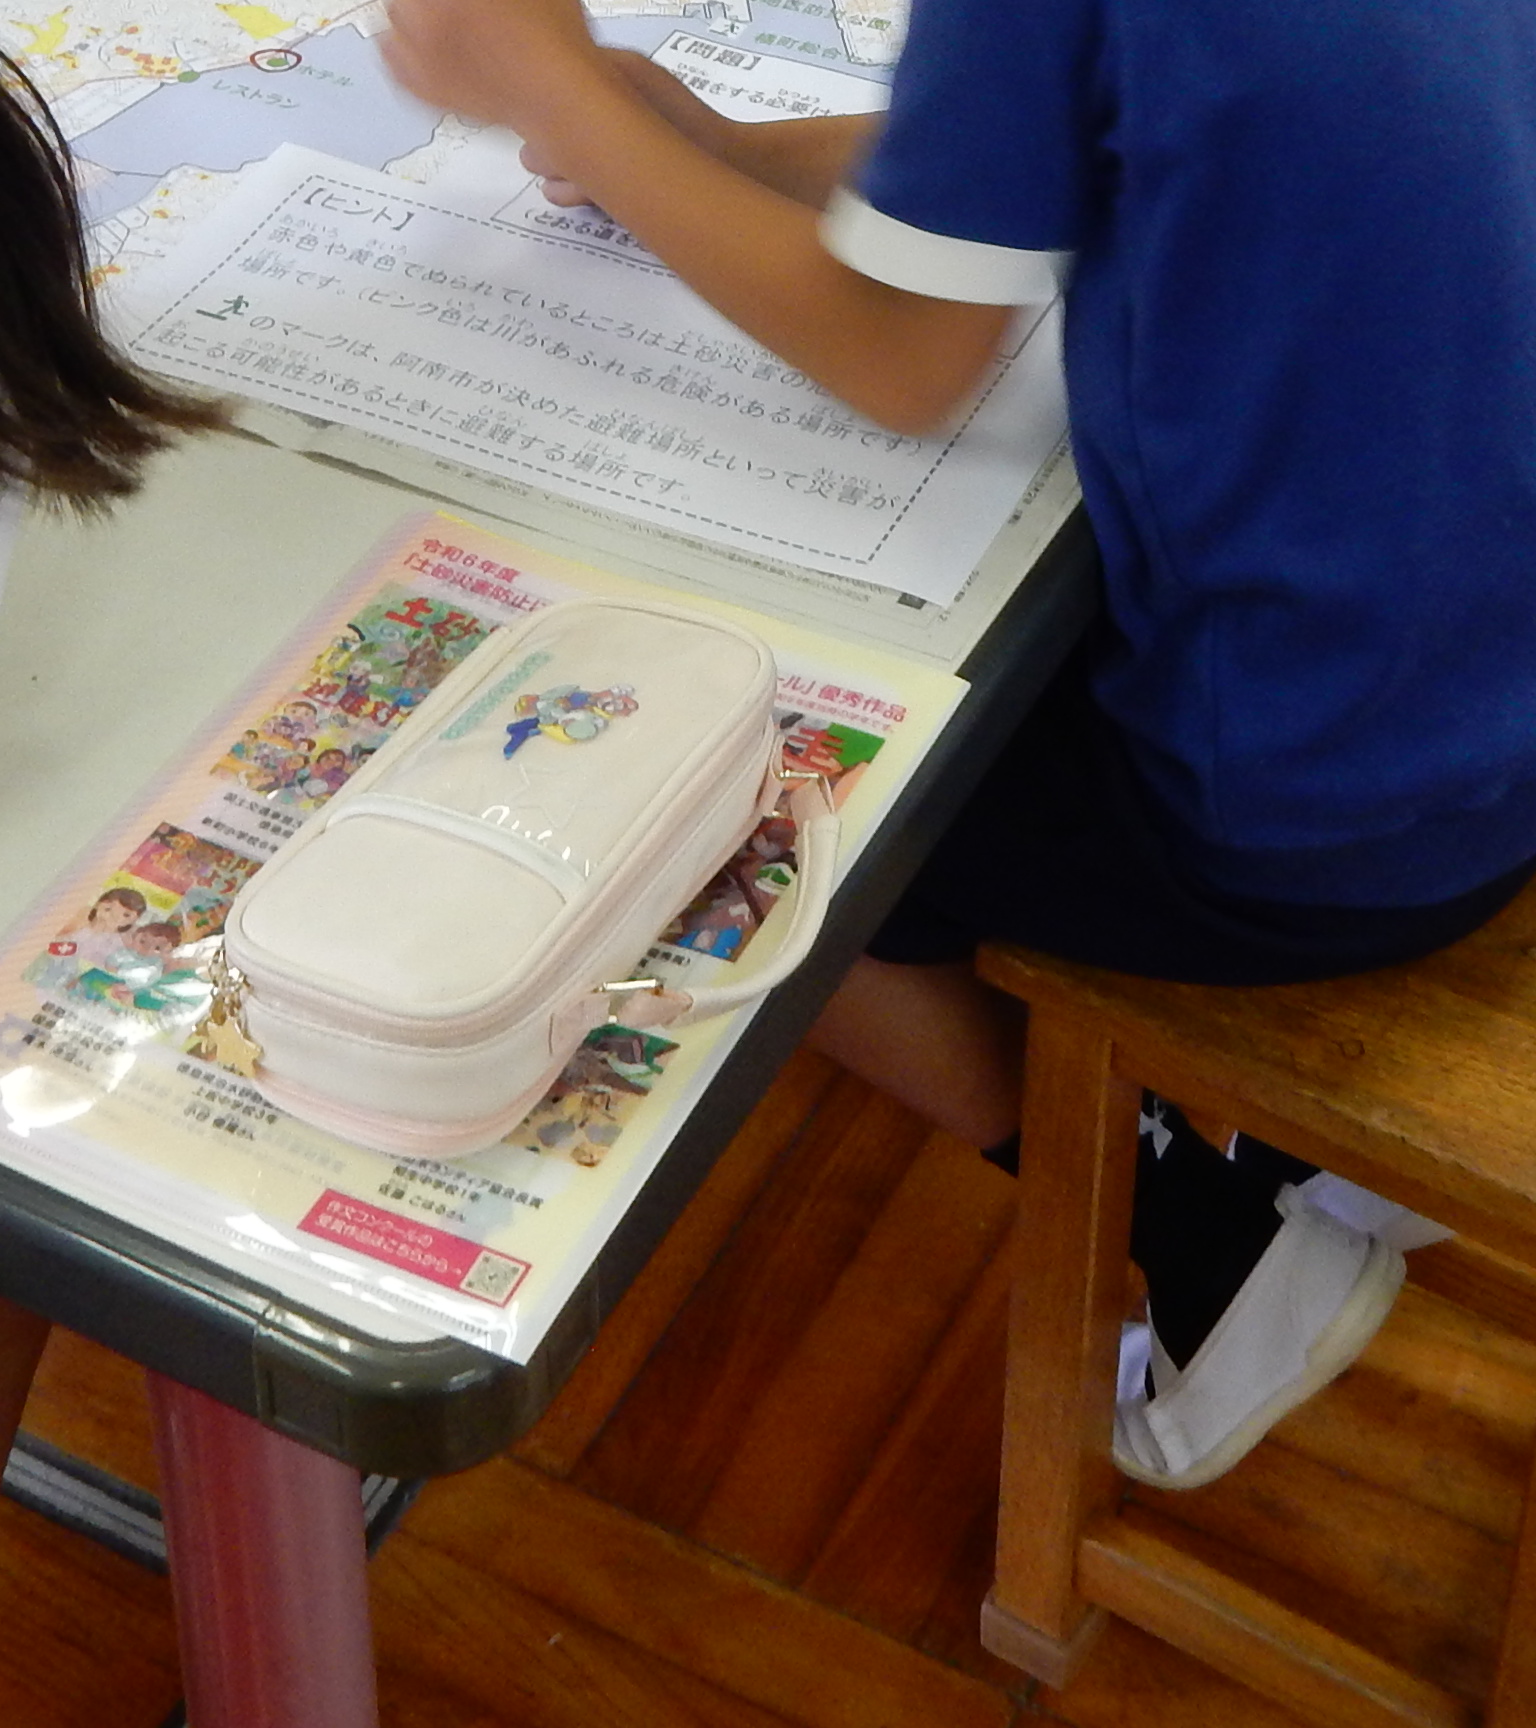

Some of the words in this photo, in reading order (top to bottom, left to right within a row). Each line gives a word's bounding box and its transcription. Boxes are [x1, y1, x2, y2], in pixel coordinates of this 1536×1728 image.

[212, 78, 300, 109] レストラン
[303, 187, 415, 232] 【ヒント】
[156, 326, 692, 503] 起こる可能性があるときに避難する場所です。
[250, 315, 901, 510] のマークは、阿南市が決めた避難場所といって災害が
[422, 538, 522, 584] 令和6年度
[384, 597, 500, 643] 土砂
